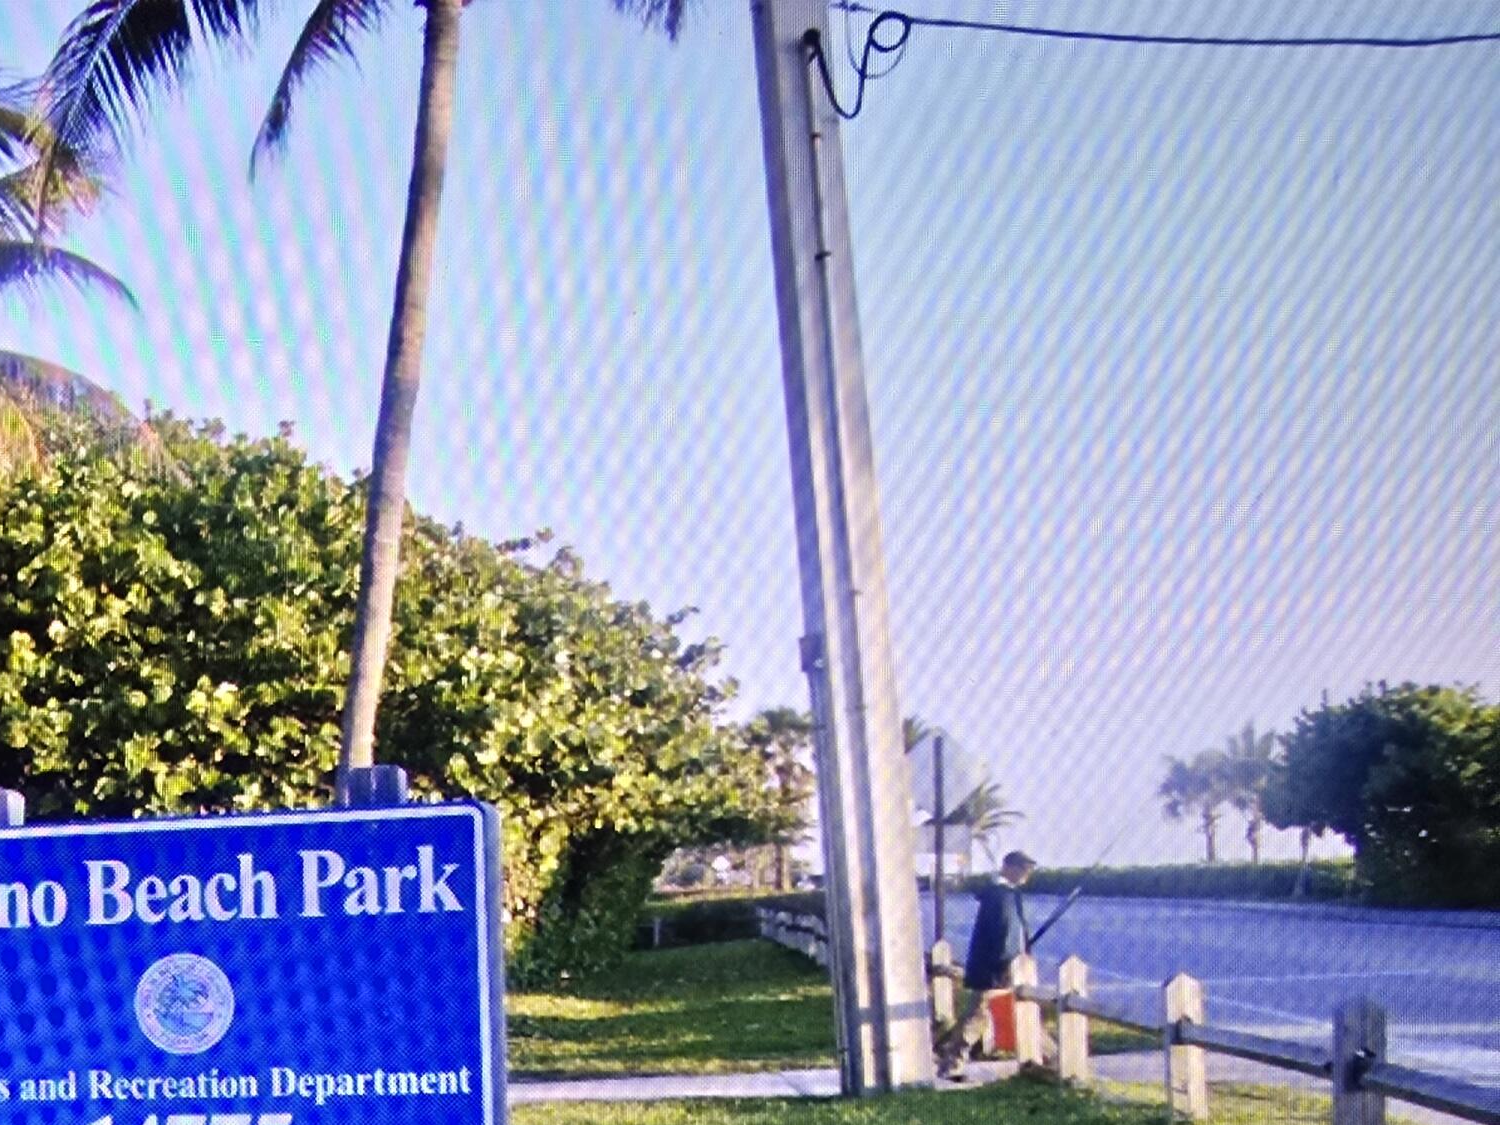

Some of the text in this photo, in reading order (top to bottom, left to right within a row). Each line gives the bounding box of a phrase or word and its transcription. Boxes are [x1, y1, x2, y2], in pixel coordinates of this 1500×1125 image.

[84, 853, 277, 926] Beach
[299, 845, 464, 918] Park
[20, 1070, 77, 1101] and
[89, 1069, 257, 1101] Recreation
[271, 1066, 472, 1105] Department
